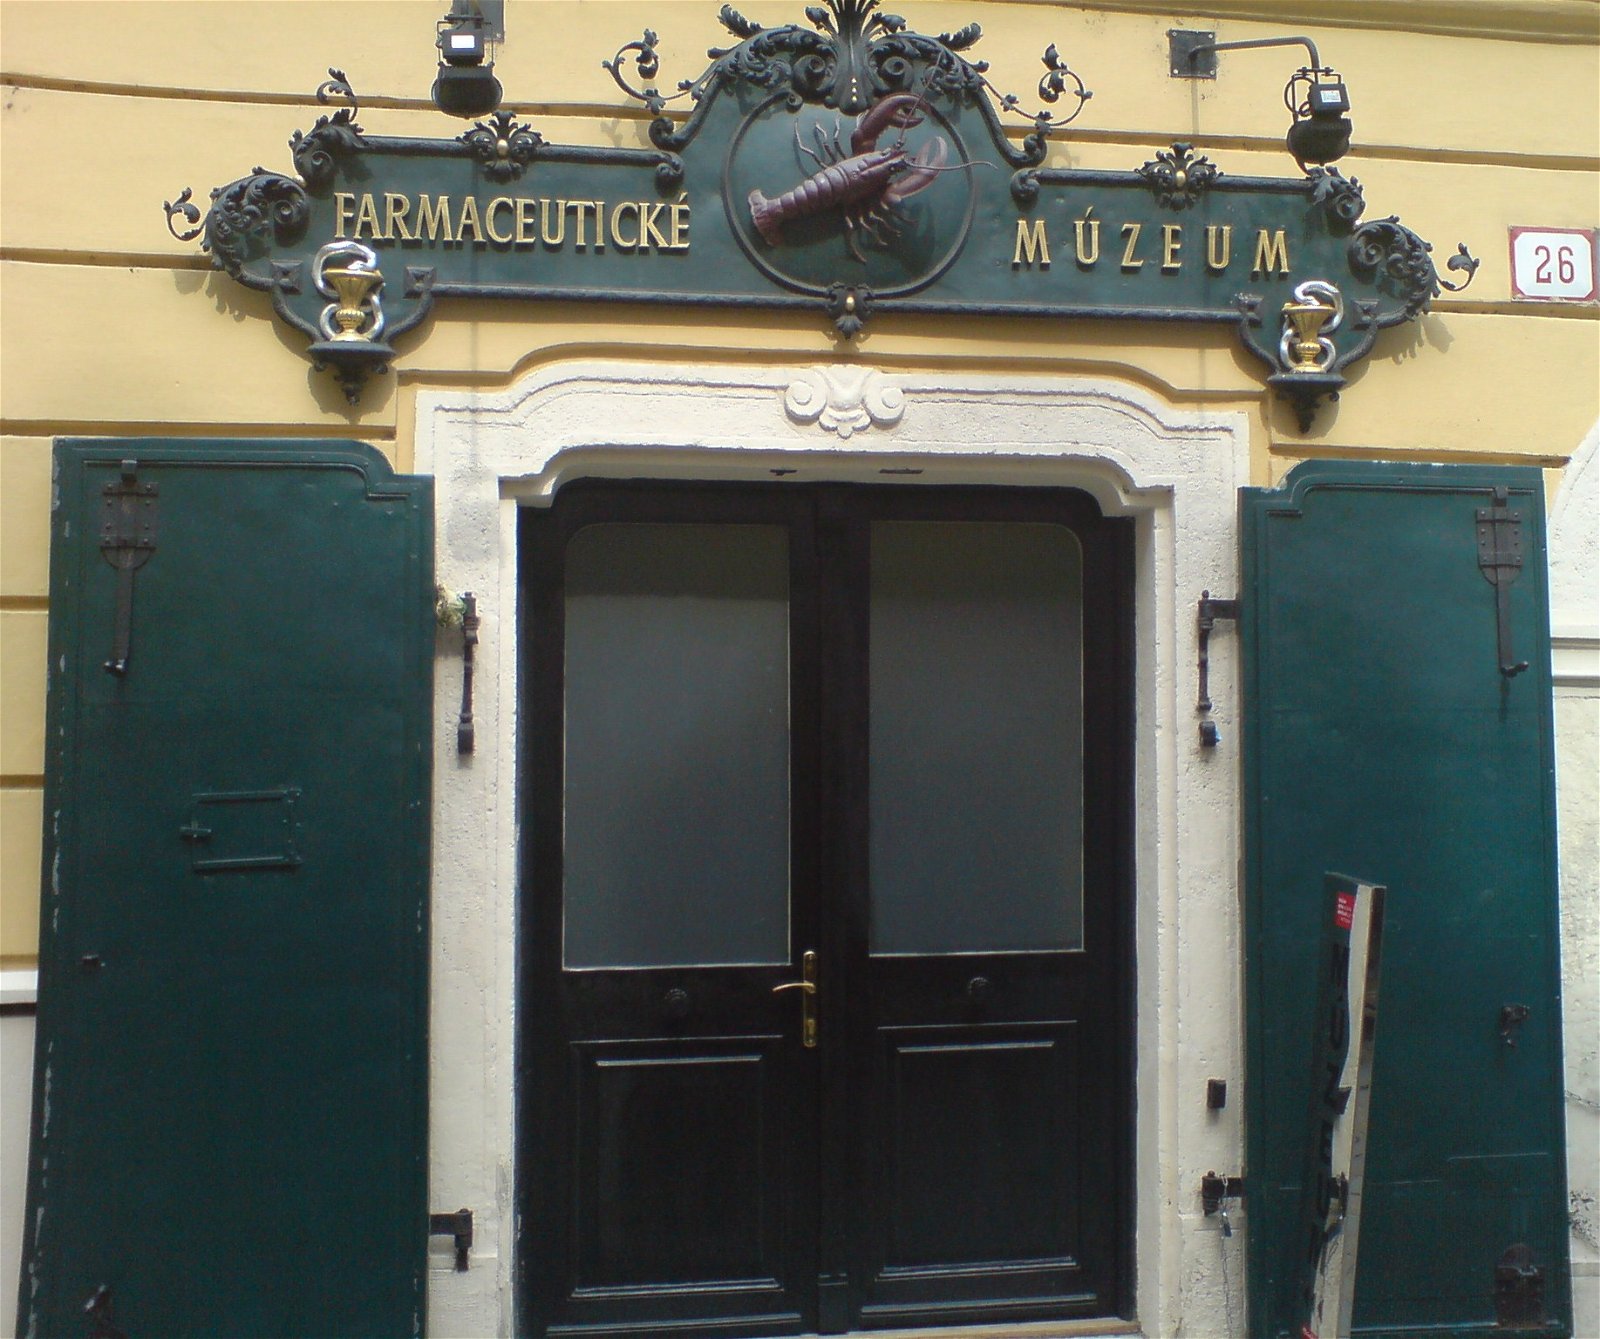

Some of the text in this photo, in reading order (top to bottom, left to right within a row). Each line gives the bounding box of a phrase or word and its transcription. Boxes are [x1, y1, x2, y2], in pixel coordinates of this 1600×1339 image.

[334, 192, 1289, 273] FARMACEUTICKÉ MÚZEUM
[1535, 245, 1574, 284] 26
